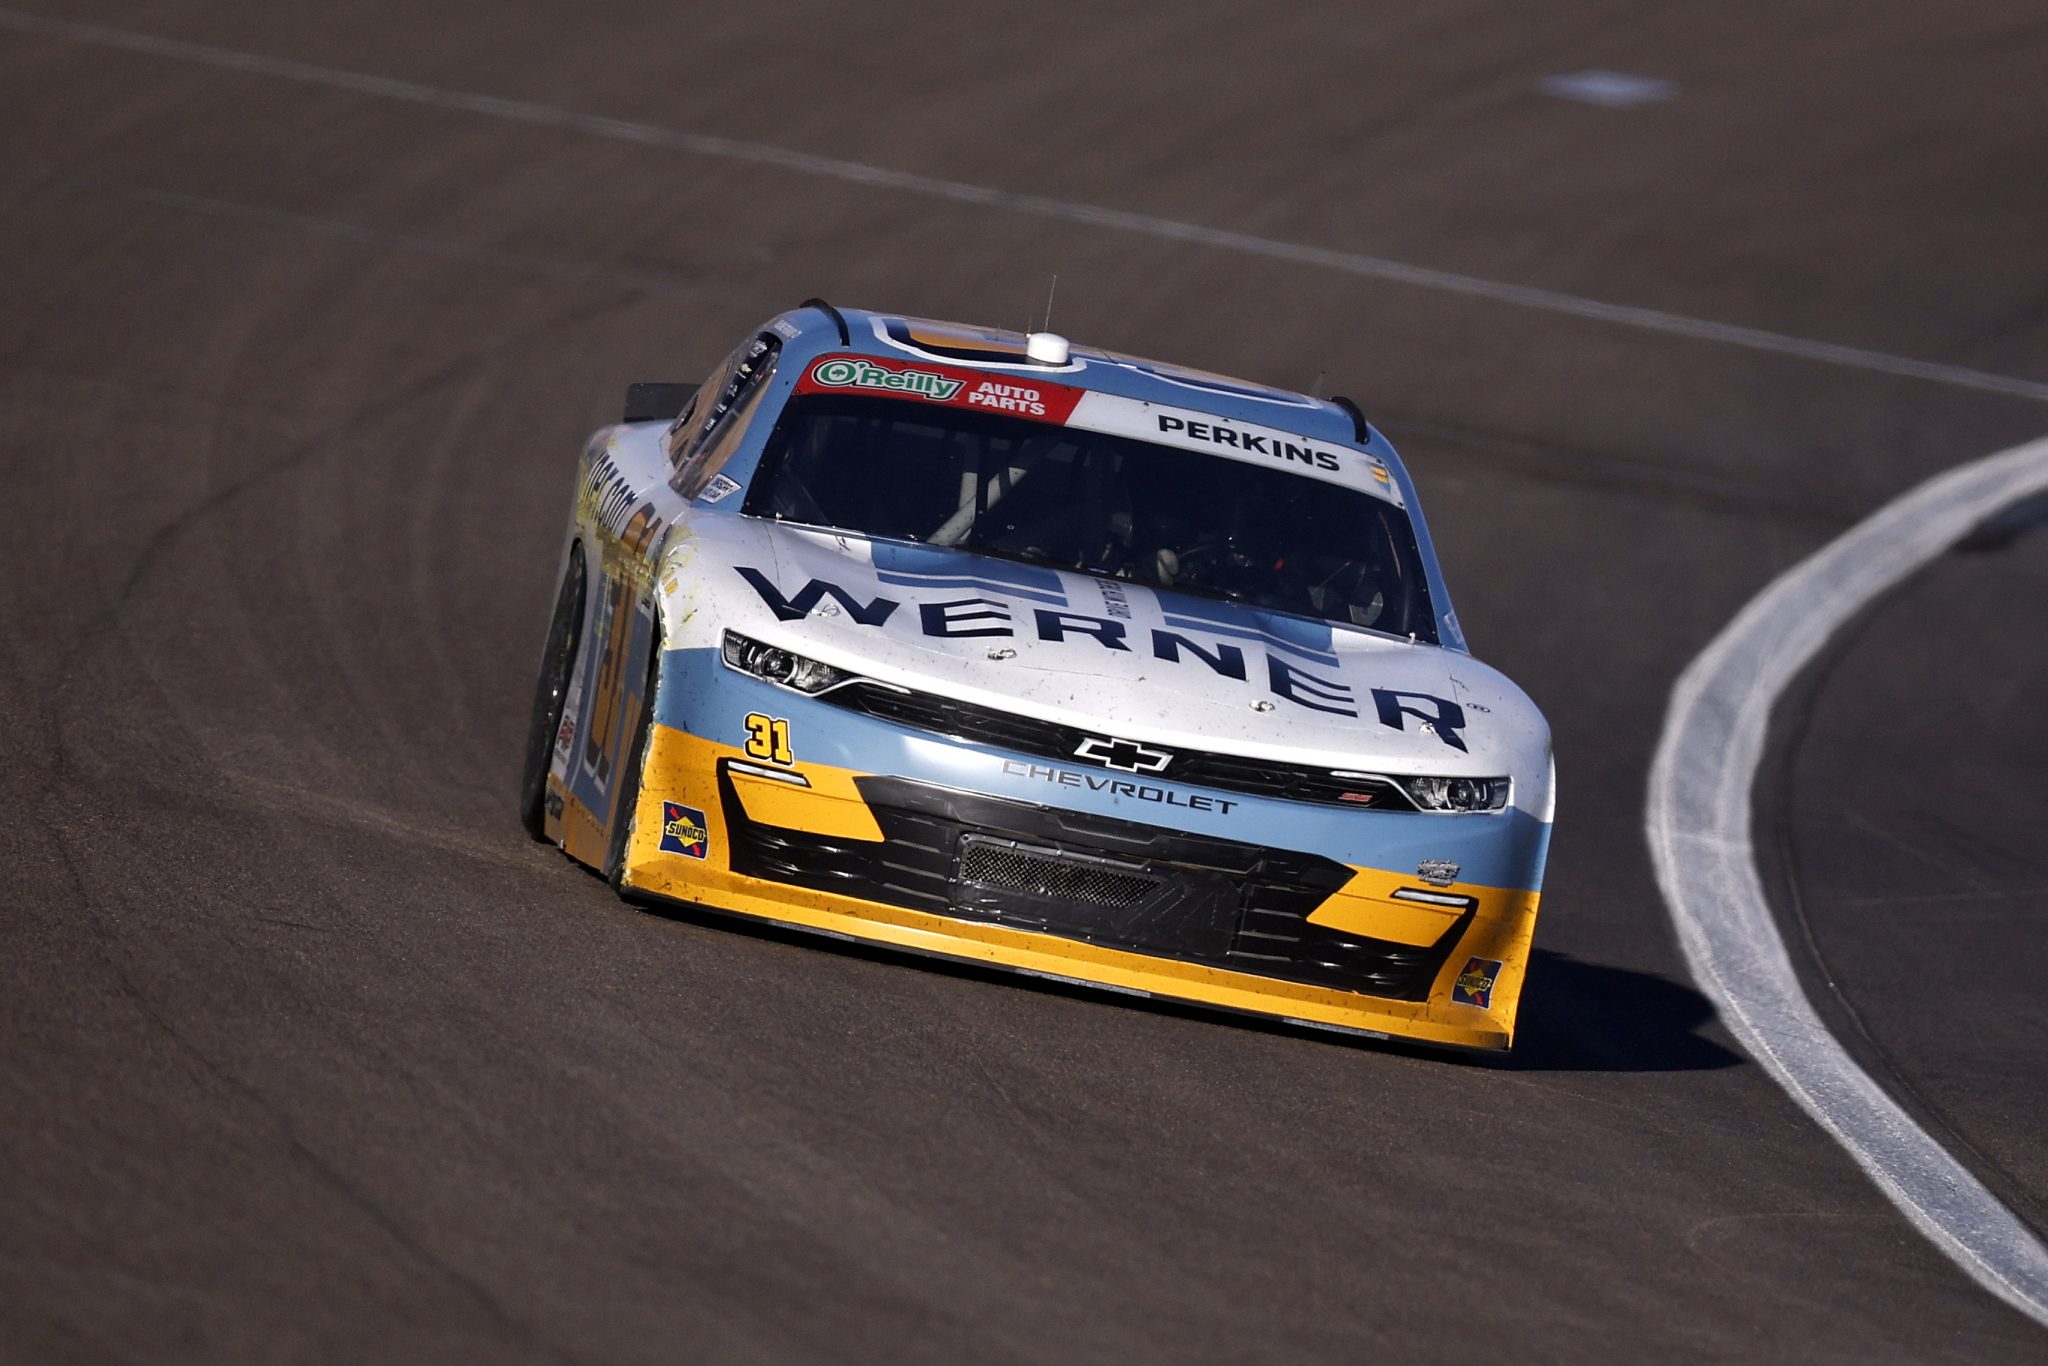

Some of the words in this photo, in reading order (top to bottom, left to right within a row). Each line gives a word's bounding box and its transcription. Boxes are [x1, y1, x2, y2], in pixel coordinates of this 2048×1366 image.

[815, 361, 960, 398] O'Reilly
[977, 381, 1040, 401] AUTO
[968, 391, 1046, 415] PARTS
[1157, 414, 1341, 472] PERKINS
[733, 565, 1469, 754] WERNER
[745, 712, 793, 766] 31
[1001, 759, 1239, 815] CHEVROLET
[667, 822, 706, 842] SUNOCO
